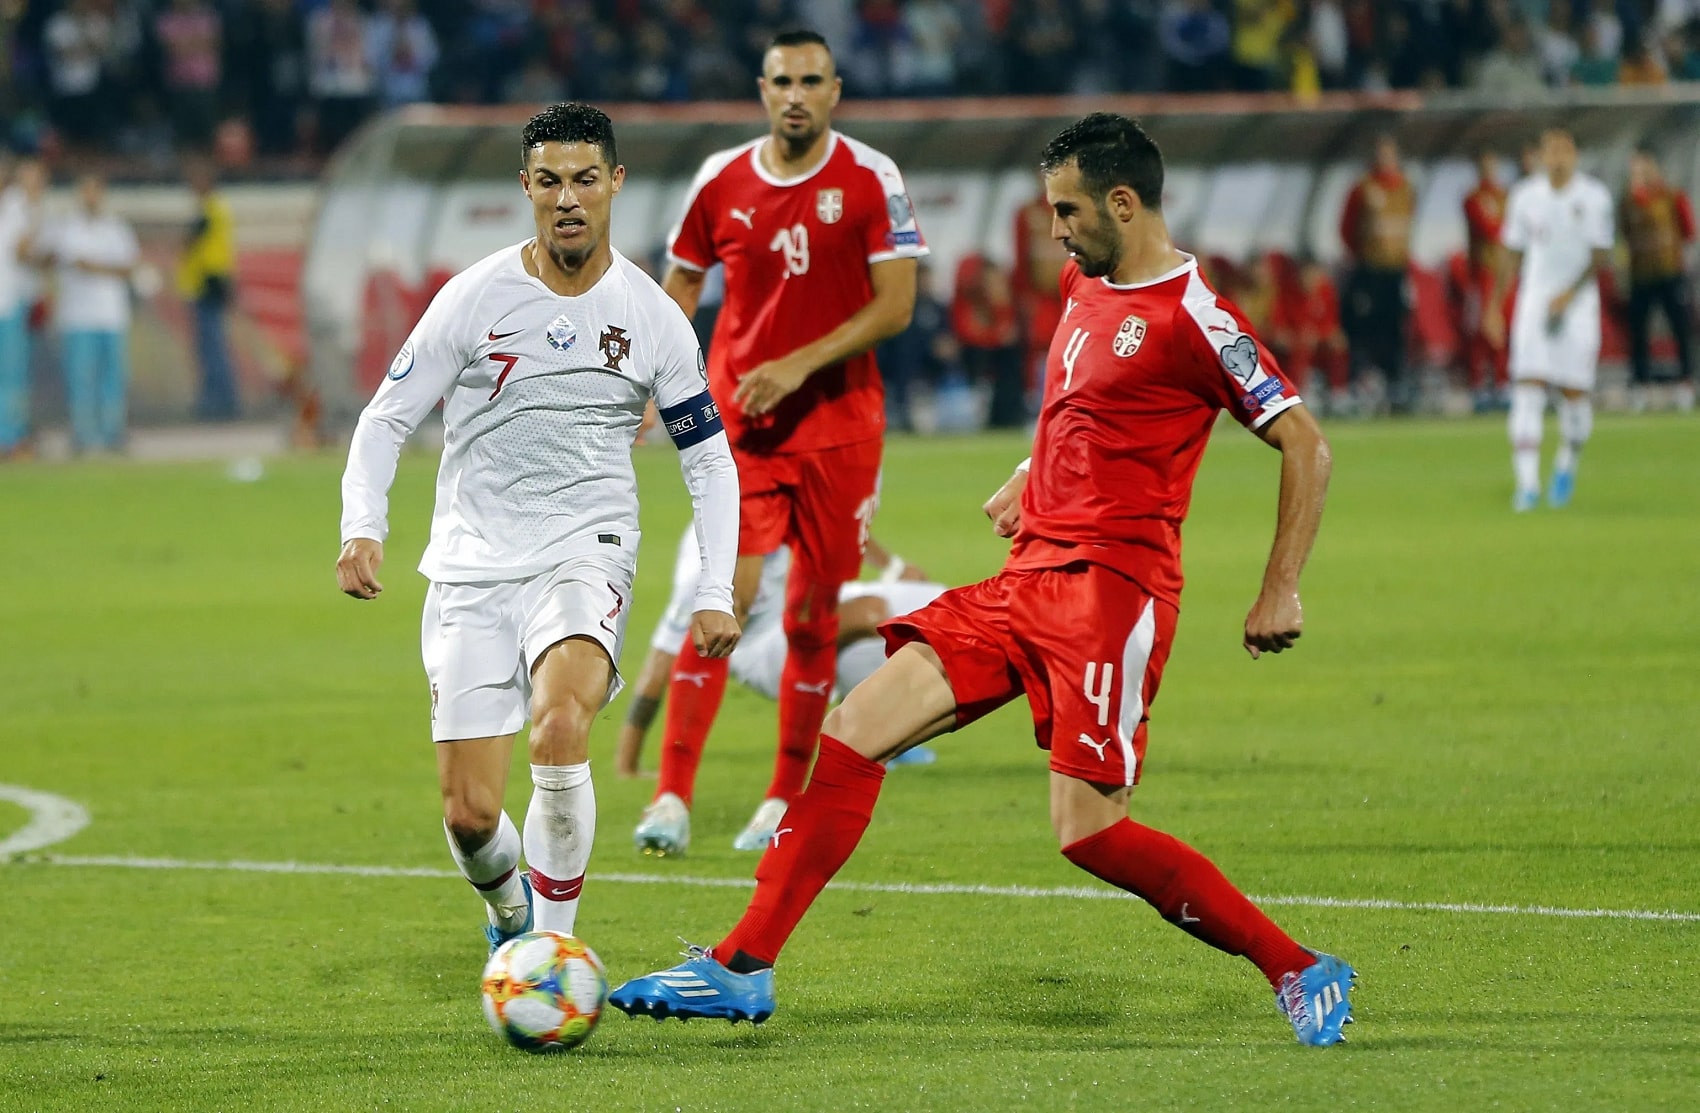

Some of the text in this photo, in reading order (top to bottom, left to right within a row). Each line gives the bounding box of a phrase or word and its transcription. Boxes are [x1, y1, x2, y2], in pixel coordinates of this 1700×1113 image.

[769, 222, 810, 280] 19
[488, 353, 520, 402] 7
[1062, 327, 1090, 391] 4
[1256, 378, 1283, 400] RESPECT
[667, 416, 694, 434] SPECT
[1083, 661, 1114, 726] 4
